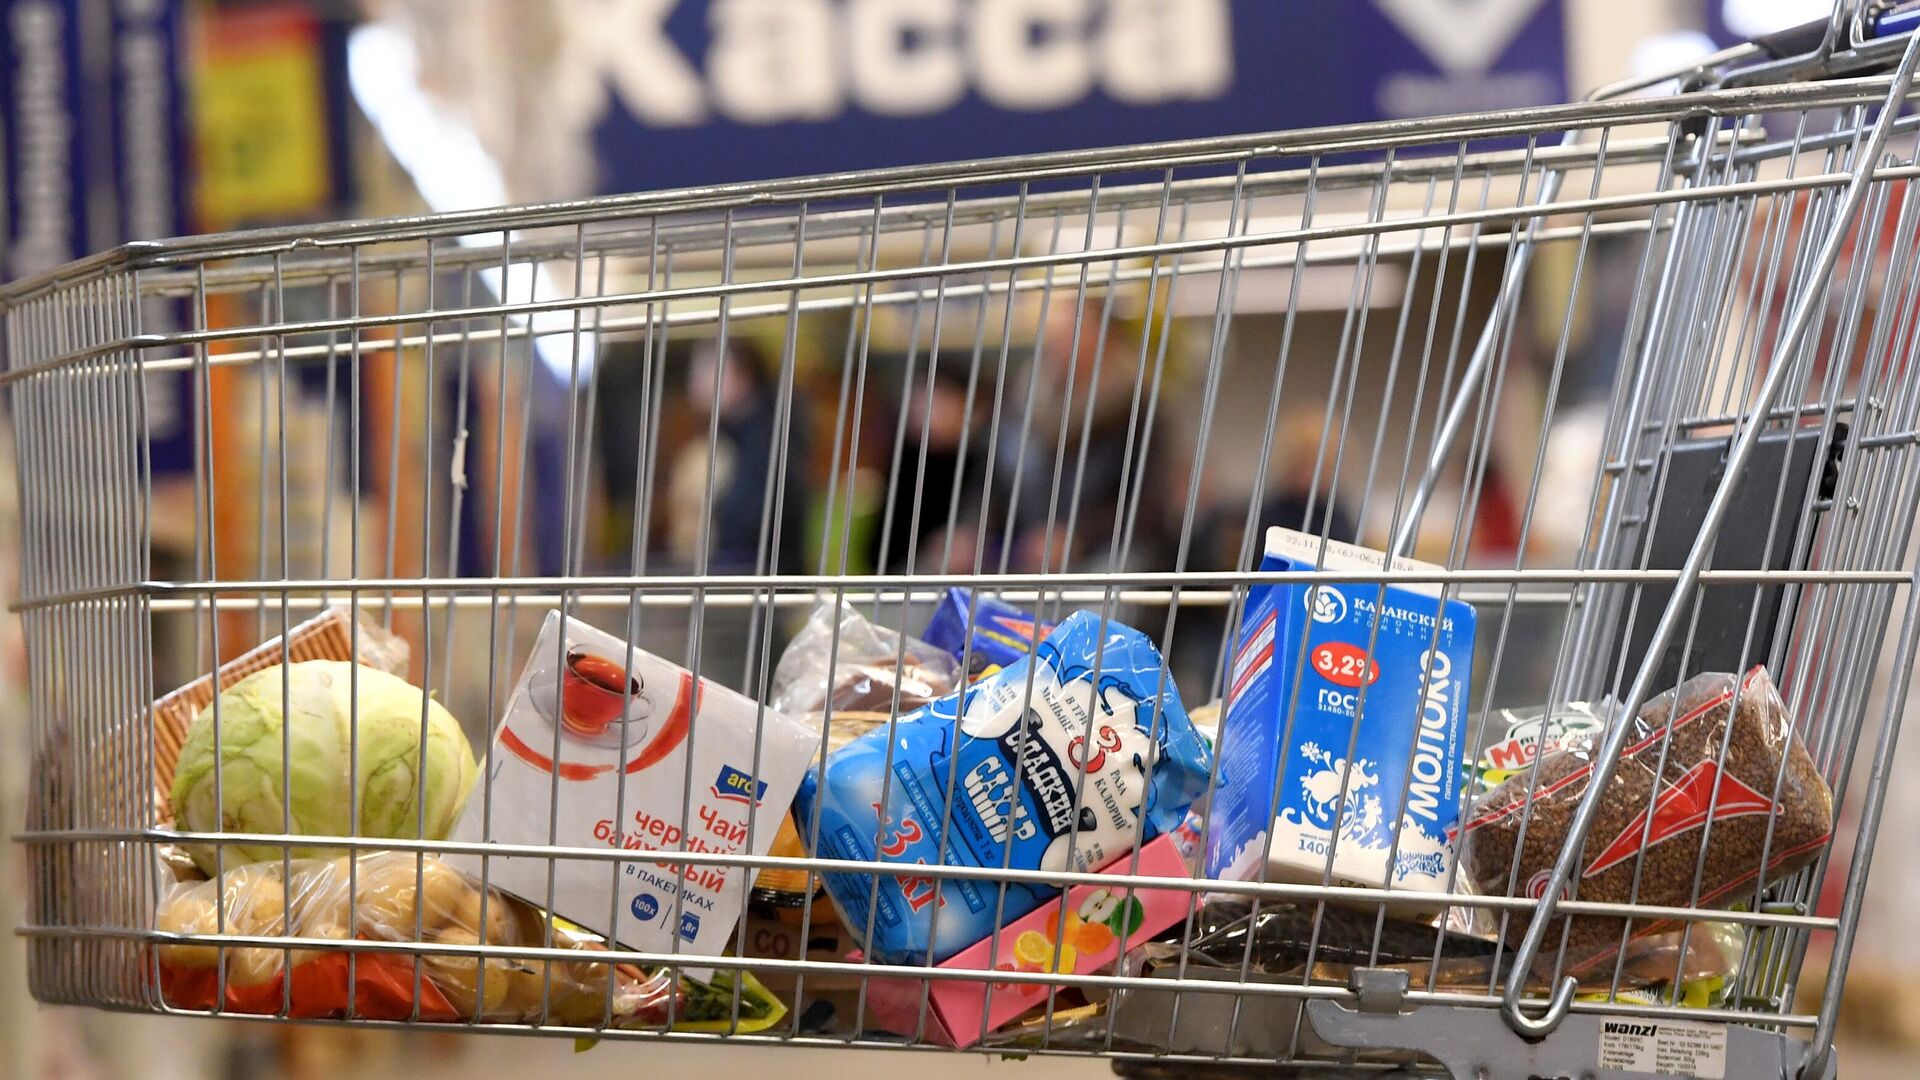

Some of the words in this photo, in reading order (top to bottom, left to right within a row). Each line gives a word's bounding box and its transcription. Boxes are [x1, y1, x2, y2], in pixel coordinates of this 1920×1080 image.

[1353, 617, 1453, 648] КОМБИНТ
[1354, 610, 1454, 641] МОЛОЧНЙ
[1318, 649, 1374, 681] 3,2%
[1317, 703, 1365, 720] 31450-20
[1318, 688, 1367, 711] ГОС
[1068, 725, 1122, 774] 3
[1408, 649, 1451, 822] МОЛОКО
[726, 772, 757, 795] aro
[1005, 730, 1075, 834] СЛАДКИЙ
[1110, 769, 1128, 796] РАЗА
[965, 755, 1037, 844] САХАР
[699, 805, 749, 846] Чай
[593, 819, 725, 893] байый
[626, 864, 636, 875] В
[637, 869, 715, 912] ПАКЕТИКАХ
[679, 919, 697, 934] ,8г
[1604, 1021, 1658, 1037] wanzl
